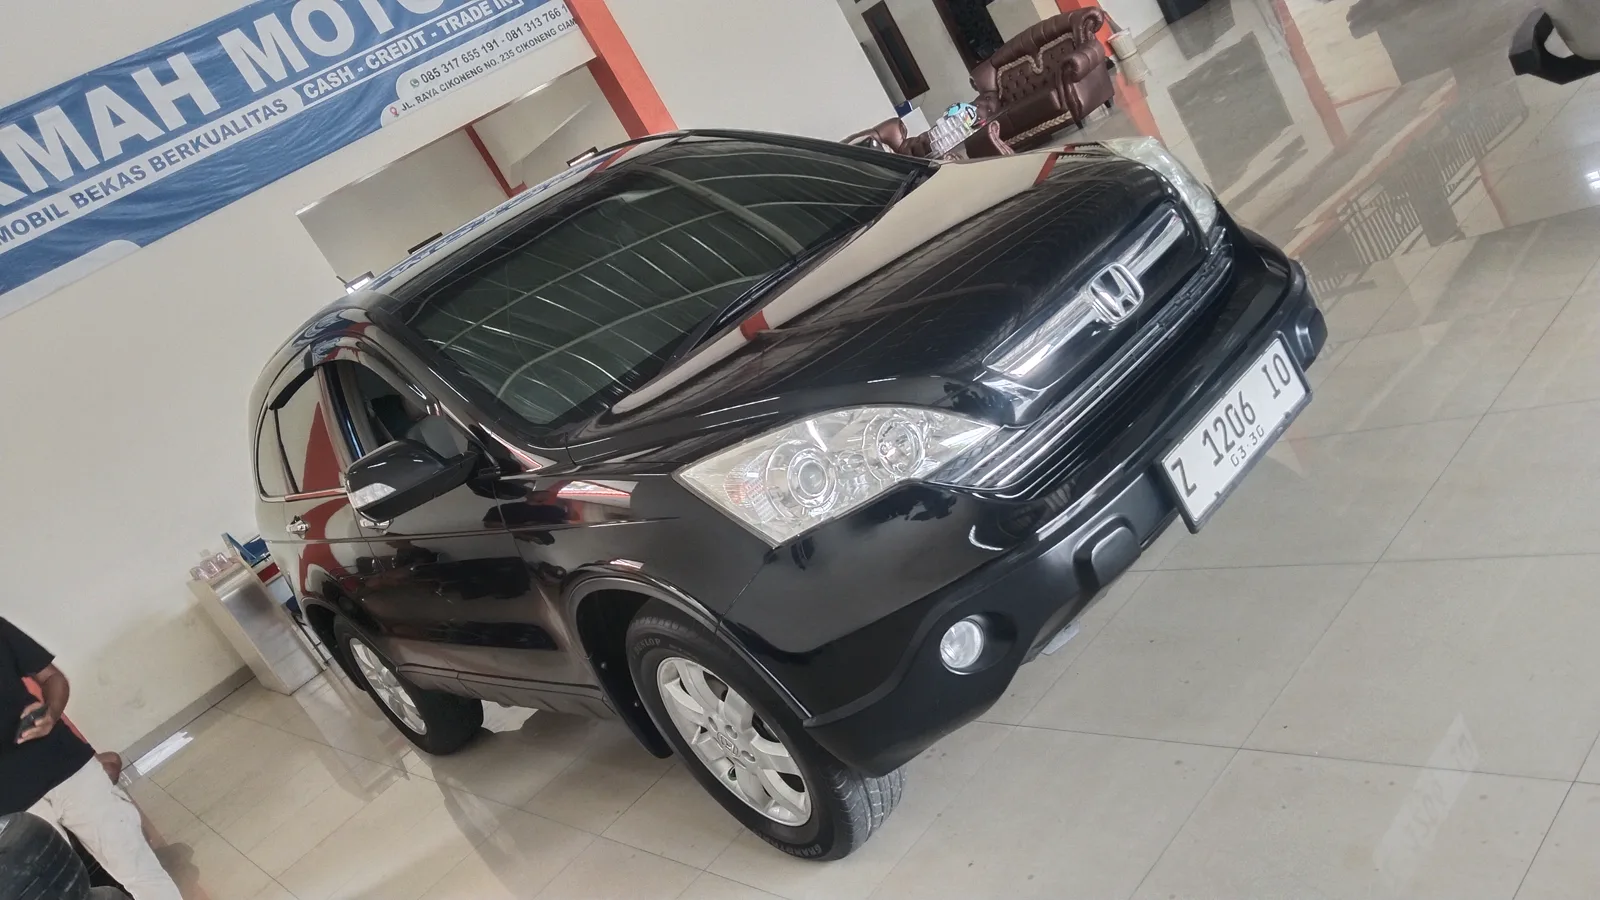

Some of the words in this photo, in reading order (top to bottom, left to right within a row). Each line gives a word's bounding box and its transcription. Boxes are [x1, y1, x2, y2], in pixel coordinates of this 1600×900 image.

[217, 0, 444, 93] MOT
[303, 66, 355, 98] CASH
[365, 31, 427, 69] CREDIT
[436, 1, 493, 34] TRADE
[401, 102, 415, 111] JL.
[415, 88, 439, 104] RAYA
[440, 66, 483, 92] CIKONENG
[483, 59, 499, 69] NO.
[499, 49, 515, 62] 235
[515, 28, 557, 53] CIKONENG
[420, 67, 441, 83] 085
[441, 58, 460, 73] 317
[461, 48, 481, 63] 655
[481, 39, 499, 53] 191
[505, 27, 524, 42] 081
[524, 17, 543, 32] 313
[542, 8, 561, 22] 766
[0, 203, 69, 245] MOBIL
[69, 165, 147, 209] BEKAS
[148, 98, 288, 173] BERKUALITAS
[1171, 457, 1197, 498] Z
[1202, 391, 1256, 467] 1206
